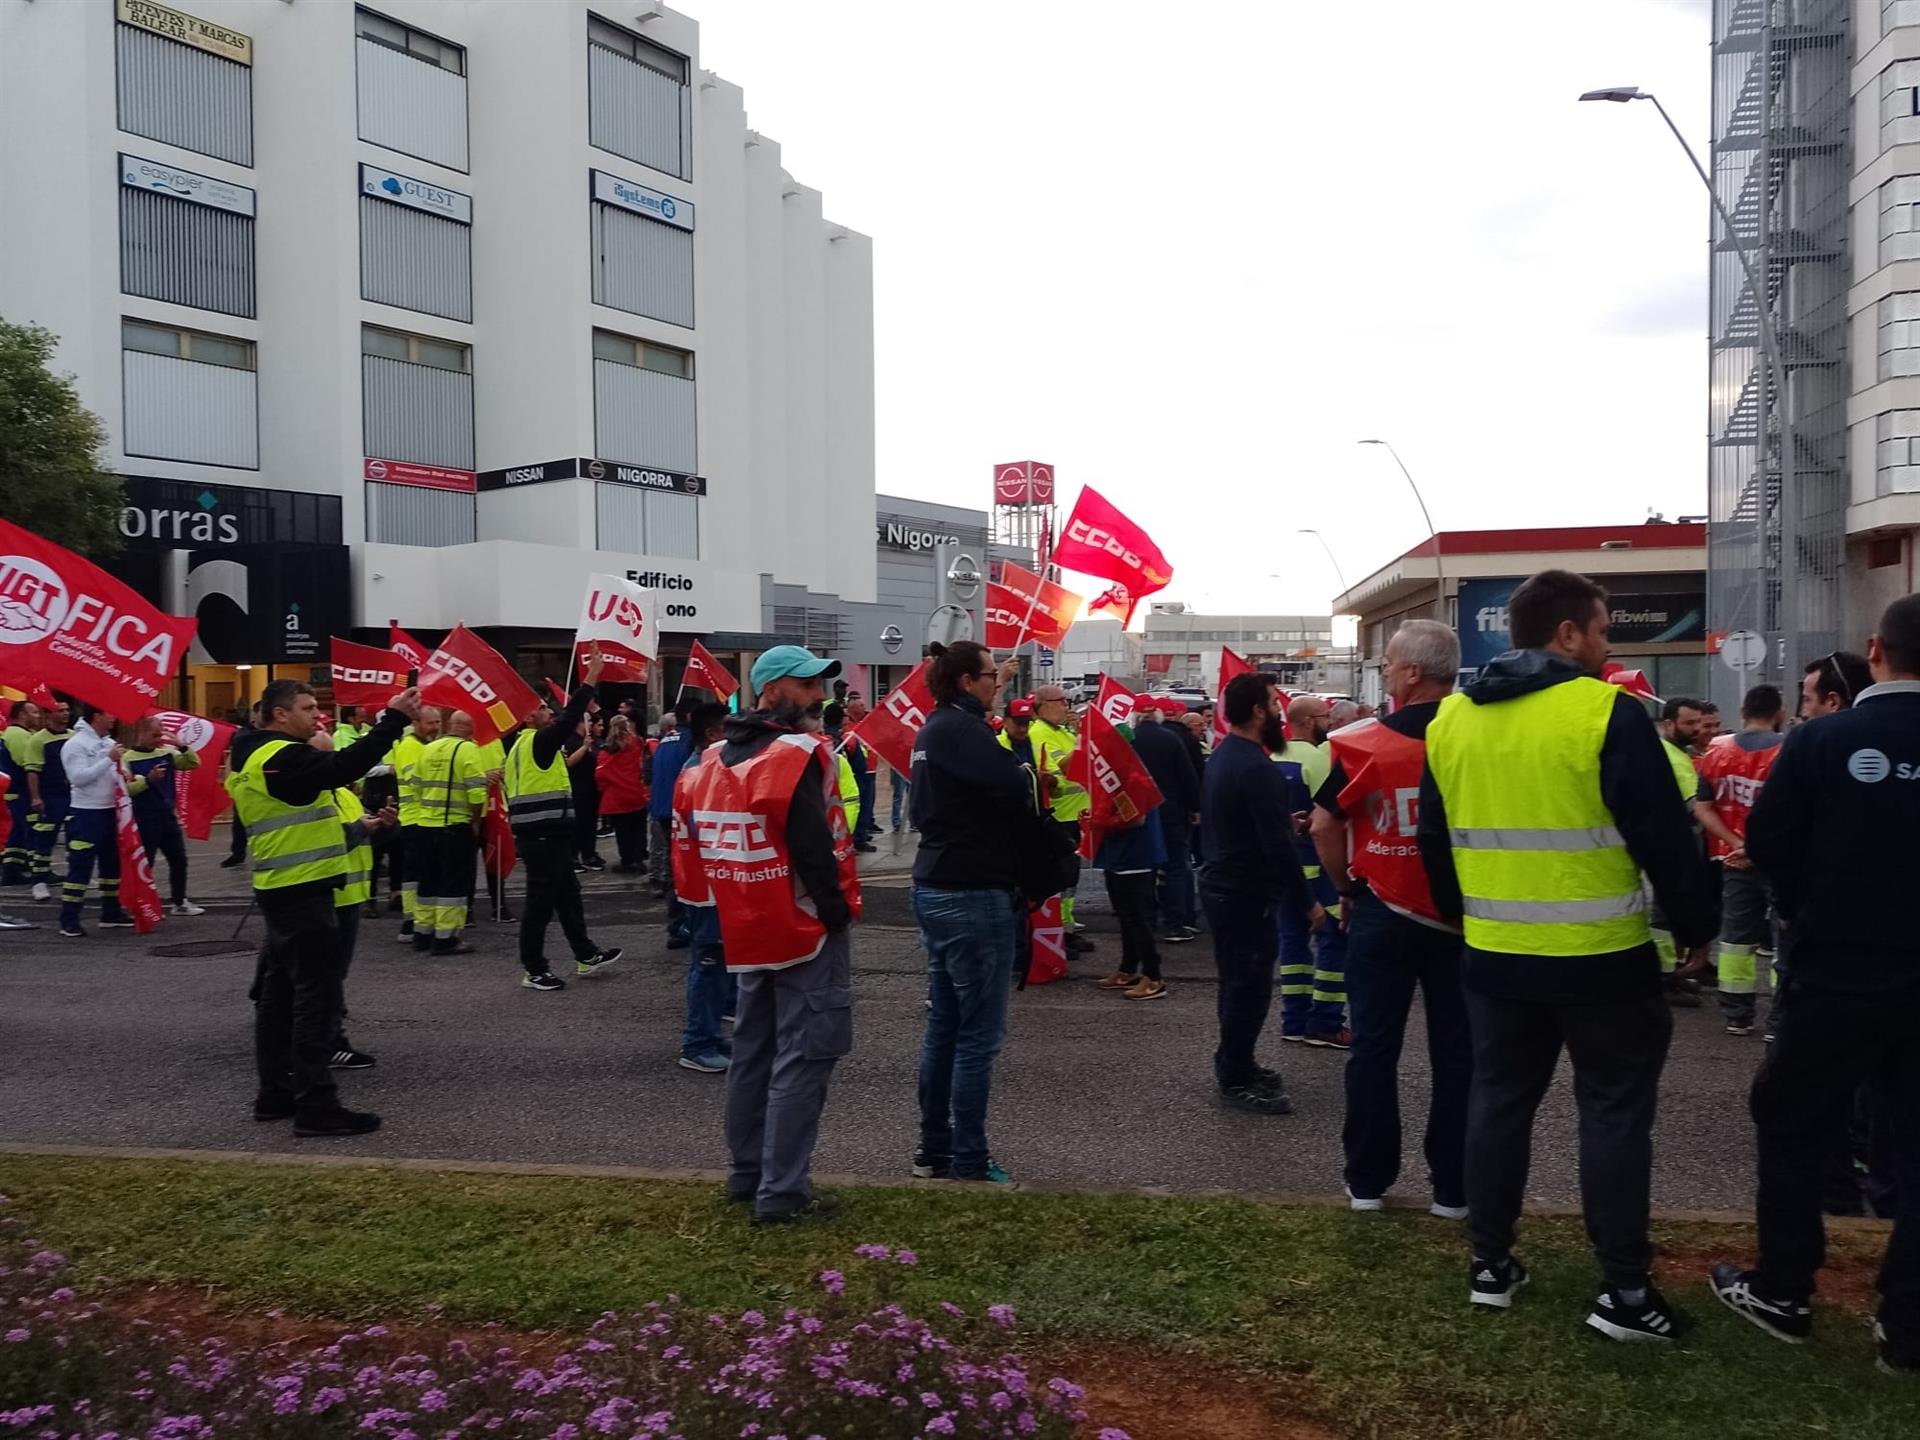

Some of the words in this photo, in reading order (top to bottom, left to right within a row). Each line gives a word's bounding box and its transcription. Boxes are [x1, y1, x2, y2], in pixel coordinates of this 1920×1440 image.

[125, 0, 185, 27] PATENTES
[189, 19, 197, 31] Y
[199, 24, 246, 49] MARCAS
[130, 11, 187, 40] BALEAR
[404, 181, 455, 207] GUEST
[614, 182, 661, 210] iSystems
[505, 466, 544, 485] NISSAN
[617, 467, 674, 488] NIGORRA
[887, 523, 959, 550] Nigorra
[1067, 518, 1142, 569] CCOO
[626, 569, 693, 590] Edificio
[60, 593, 173, 676] FICA
[580, 653, 627, 665] COO
[331, 663, 395, 685] CCOO
[425, 649, 498, 704] CCOO
